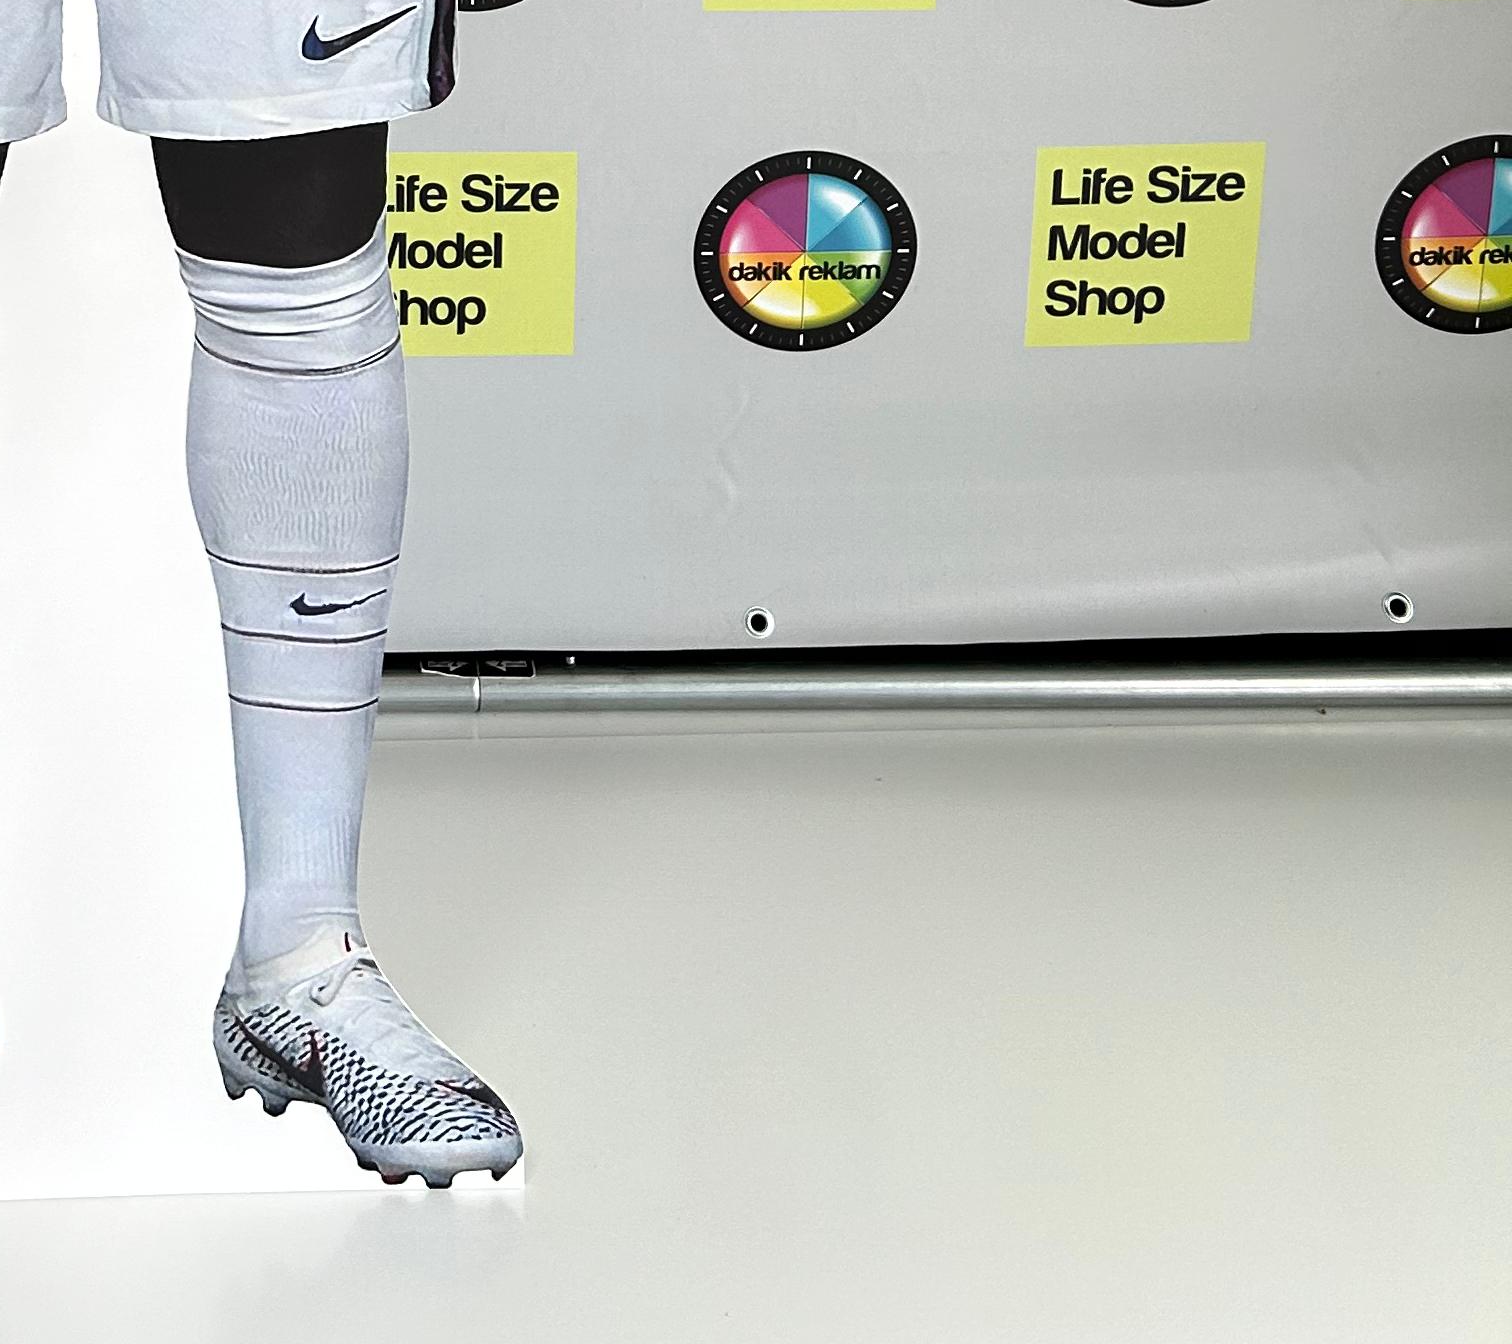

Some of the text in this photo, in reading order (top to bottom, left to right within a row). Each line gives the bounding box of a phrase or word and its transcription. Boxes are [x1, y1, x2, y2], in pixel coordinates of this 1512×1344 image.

[387, 173, 560, 213] ife Size
[1051, 165, 1246, 206] Life Size
[1047, 222, 1186, 261] Model
[1408, 245, 1474, 267] dakik
[728, 260, 882, 282] dakik reklam
[394, 289, 487, 336] hop
[1044, 279, 1165, 325] Shop
